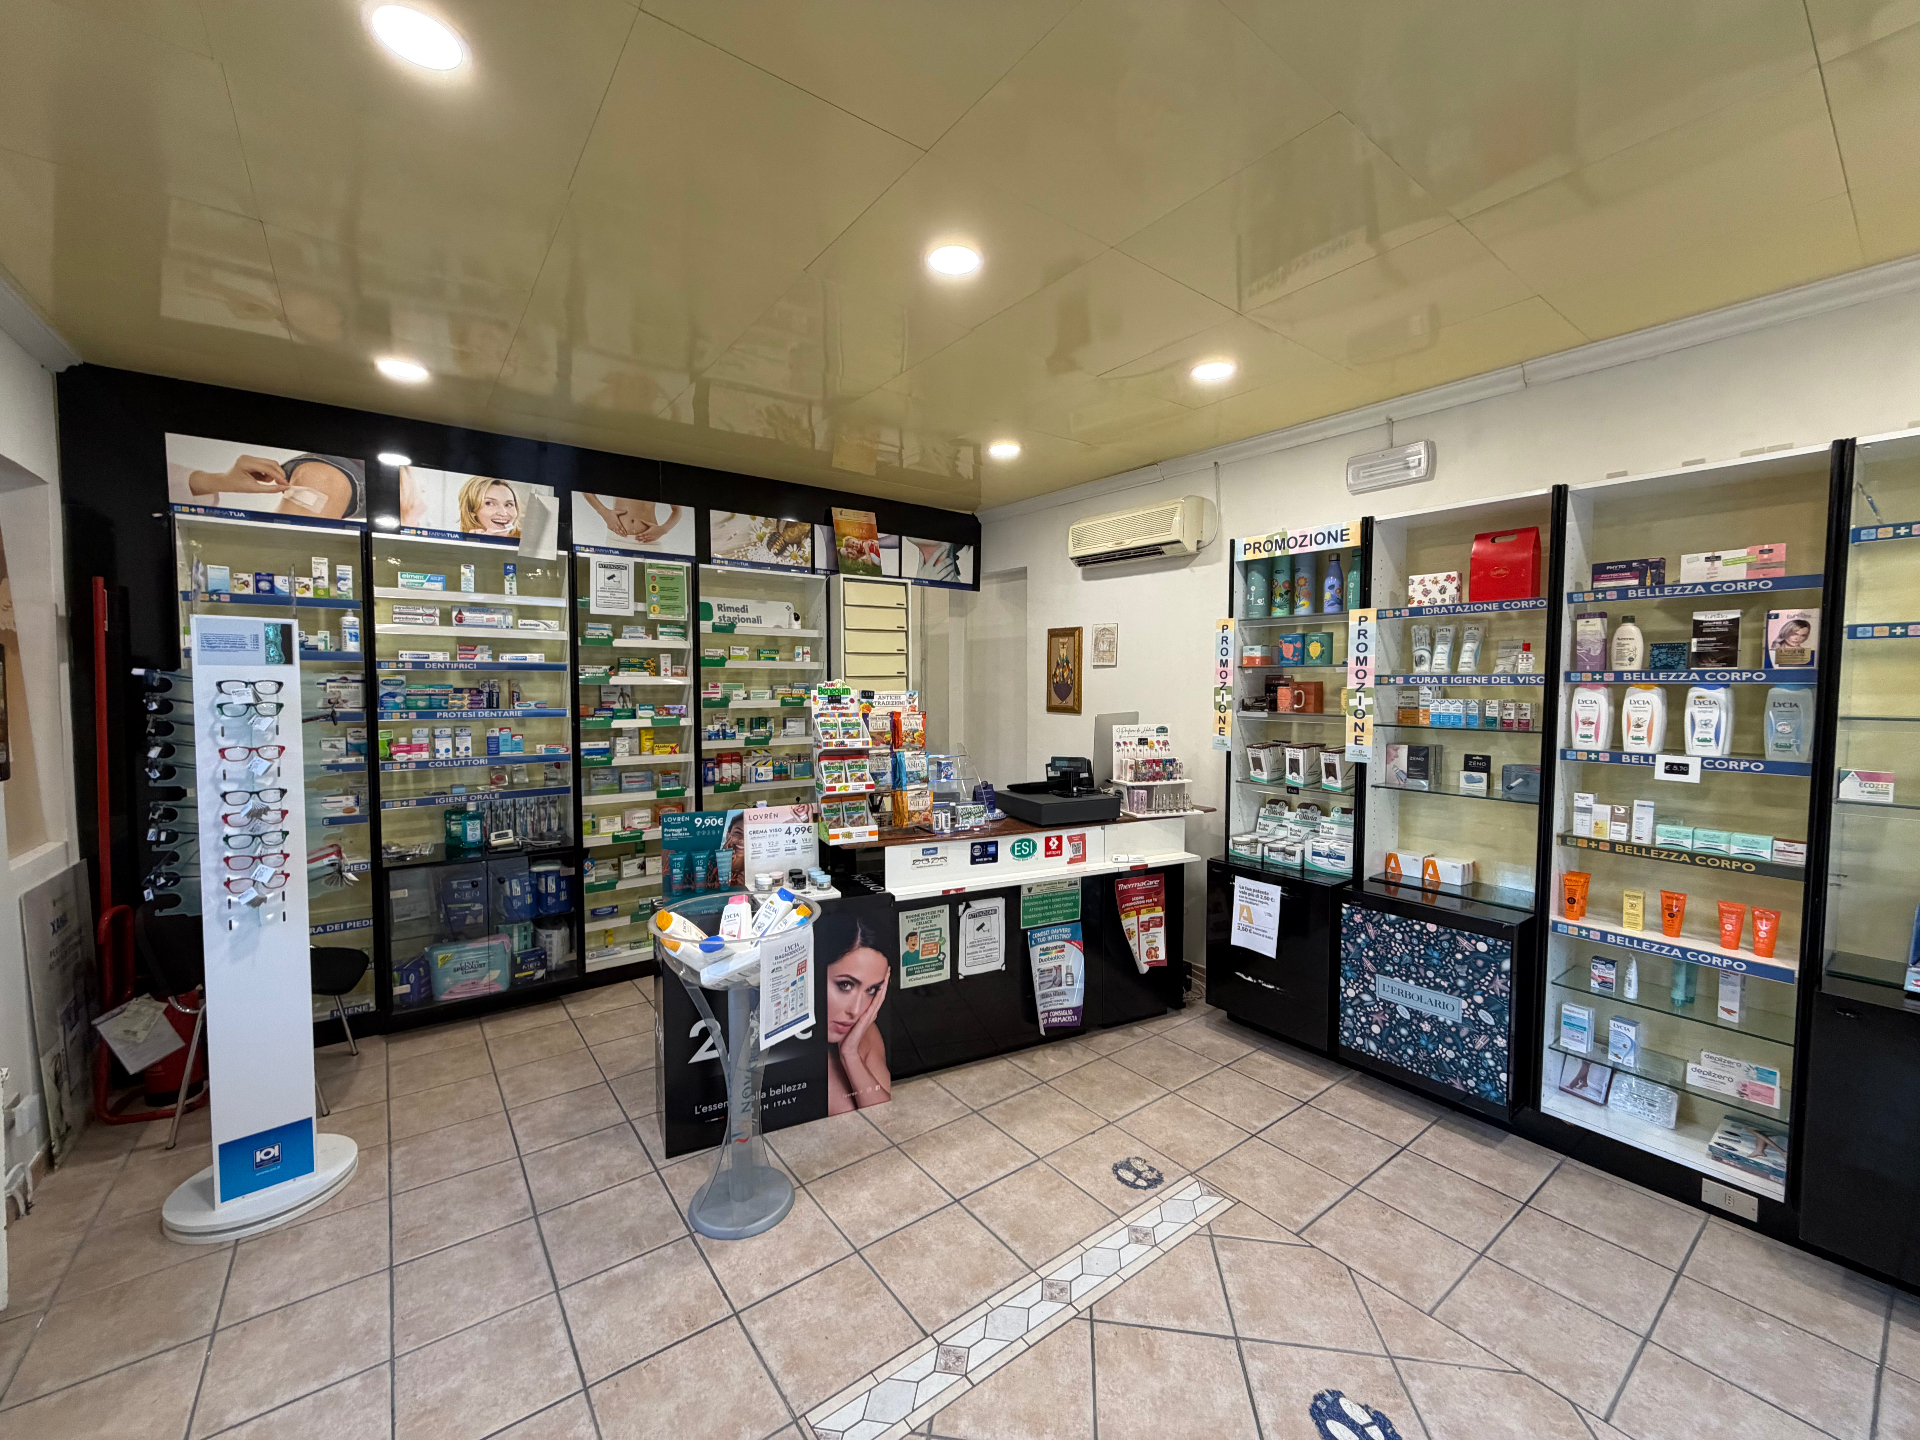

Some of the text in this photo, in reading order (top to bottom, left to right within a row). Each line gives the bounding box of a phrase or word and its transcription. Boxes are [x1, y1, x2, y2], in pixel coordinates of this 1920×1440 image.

[428, 530, 460, 539] FARMATUA
[1243, 527, 1351, 556] PROMOZIONE
[1627, 580, 1774, 599] BELLEZZA CORPO
[716, 603, 749, 614] Rimedi
[1422, 598, 1547, 616] IDRATAZIONE CORPO
[718, 614, 763, 625] stagionali
[424, 662, 477, 670] DENTIFRICI
[1218, 624, 1229, 737] PROMOZIONE
[1353, 615, 1369, 746] PROMOZIONE
[1409, 676, 1439, 685] CURA
[1441, 676, 1448, 685] E
[1450, 676, 1489, 685] IGIENE
[1491, 676, 1514, 685] DEL
[1622, 671, 1767, 682] BELLEZZA CORPO
[1772, 701, 1799, 709] LYCIA
[436, 709, 523, 719] PROTESI DENTARIE
[428, 758, 488, 768] COLLUTTORI
[1621, 754, 1765, 772] BELL CORPO
[435, 793, 501, 805] IGIENE ORALE
[748, 812, 779, 821] LOVRÉN
[694, 817, 724, 829] 9,90€
[784, 825, 813, 837] 4,99€
[1014, 840, 1033, 856] ESI
[1615, 844, 1756, 872] BELLEZZA CORPO
[454, 891, 480, 899] MEN
[764, 903, 778, 915] LYCIA
[723, 912, 740, 921] LYCIA
[326, 923, 344, 932] DEI
[346, 918, 373, 929] PIEDI
[1606, 933, 1747, 972] BELLEZZA CORPO
[1381, 982, 1456, 1013] L'ERBOLARIO
[1613, 1022, 1631, 1033] LYCIA
[1704, 1053, 1742, 1068] depilzero
[1690, 1066, 1734, 1083] depilzero
[769, 1081, 807, 1097] bellezza
[773, 1096, 798, 1109] ITALY
